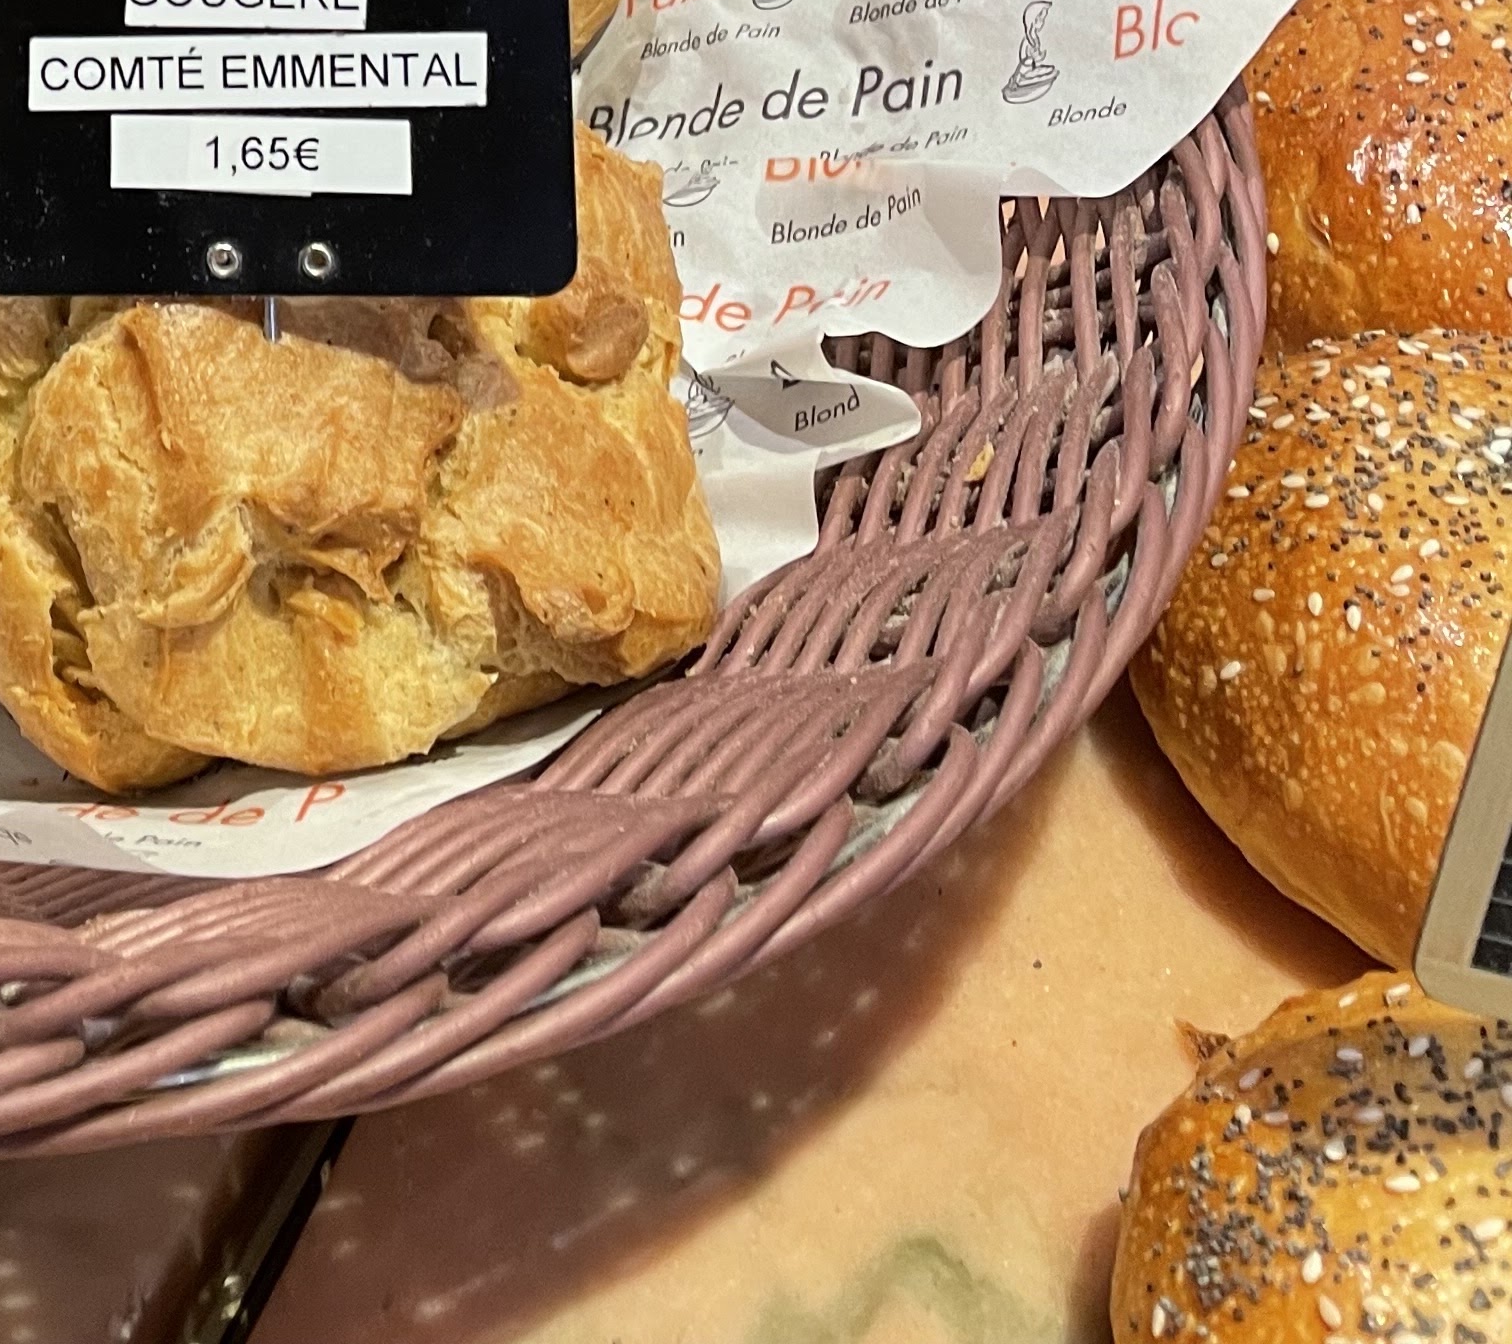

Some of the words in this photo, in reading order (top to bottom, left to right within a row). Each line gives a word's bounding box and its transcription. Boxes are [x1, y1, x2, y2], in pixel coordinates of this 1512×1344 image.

[641, 30, 700, 61] Blonde
[706, 23, 728, 46] de
[735, 23, 781, 40] Pain
[40, 47, 205, 92] COMTÉ
[222, 52, 478, 90] EMMENTAL
[590, 82, 745, 147] Blonde
[762, 68, 829, 120] de
[852, 59, 963, 117] Pain
[1048, 96, 1127, 127] Blonde
[205, 136, 320, 177] 1,65€
[924, 126, 968, 149] Pain
[771, 212, 847, 244] Blonde
[856, 204, 881, 230] de
[888, 186, 921, 220] Pain
[678, 282, 752, 332] de
[773, 277, 891, 326] Pin
[794, 383, 861, 432] Blond
[168, 798, 265, 826] de
[294, 780, 347, 823] P
